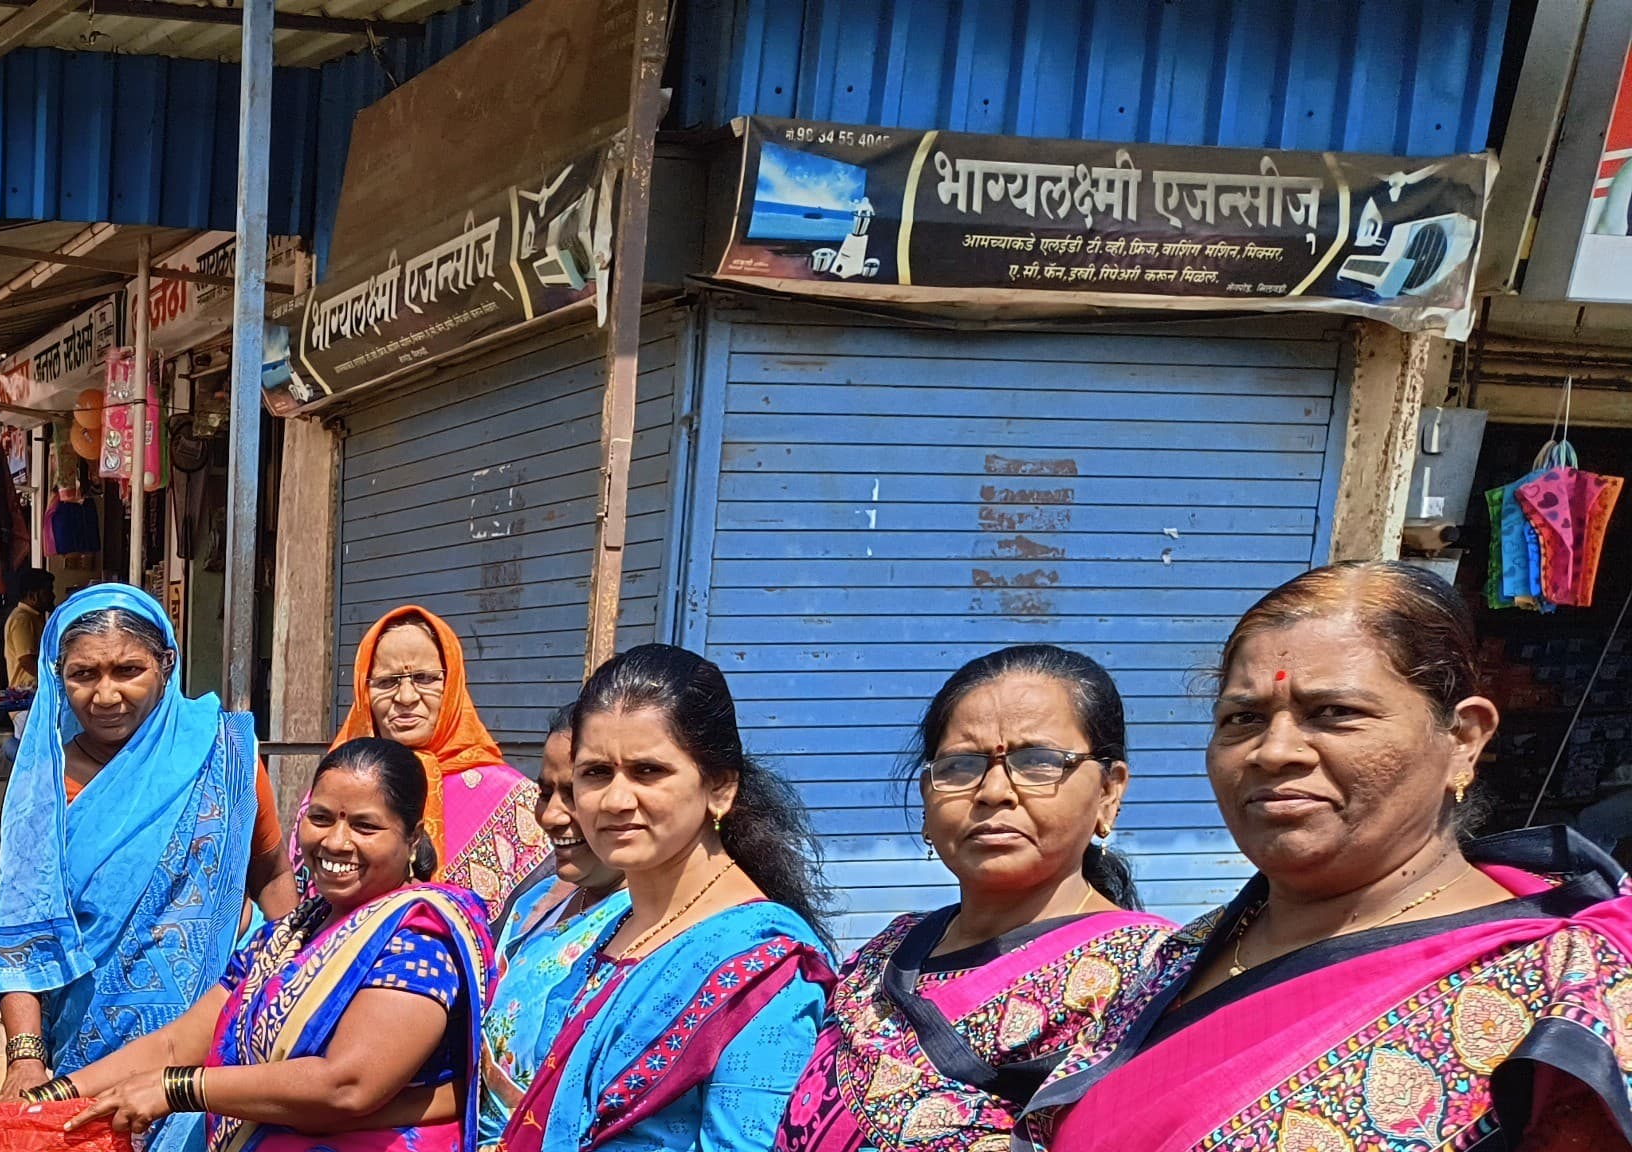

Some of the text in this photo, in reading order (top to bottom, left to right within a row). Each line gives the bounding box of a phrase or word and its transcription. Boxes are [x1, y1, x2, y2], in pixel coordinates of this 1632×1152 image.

[839, 130, 855, 146] 55
[934, 149, 1142, 229] भाग्यलक्ष्मी
[311, 248, 402, 352] भाग्यलक्ष्मी
